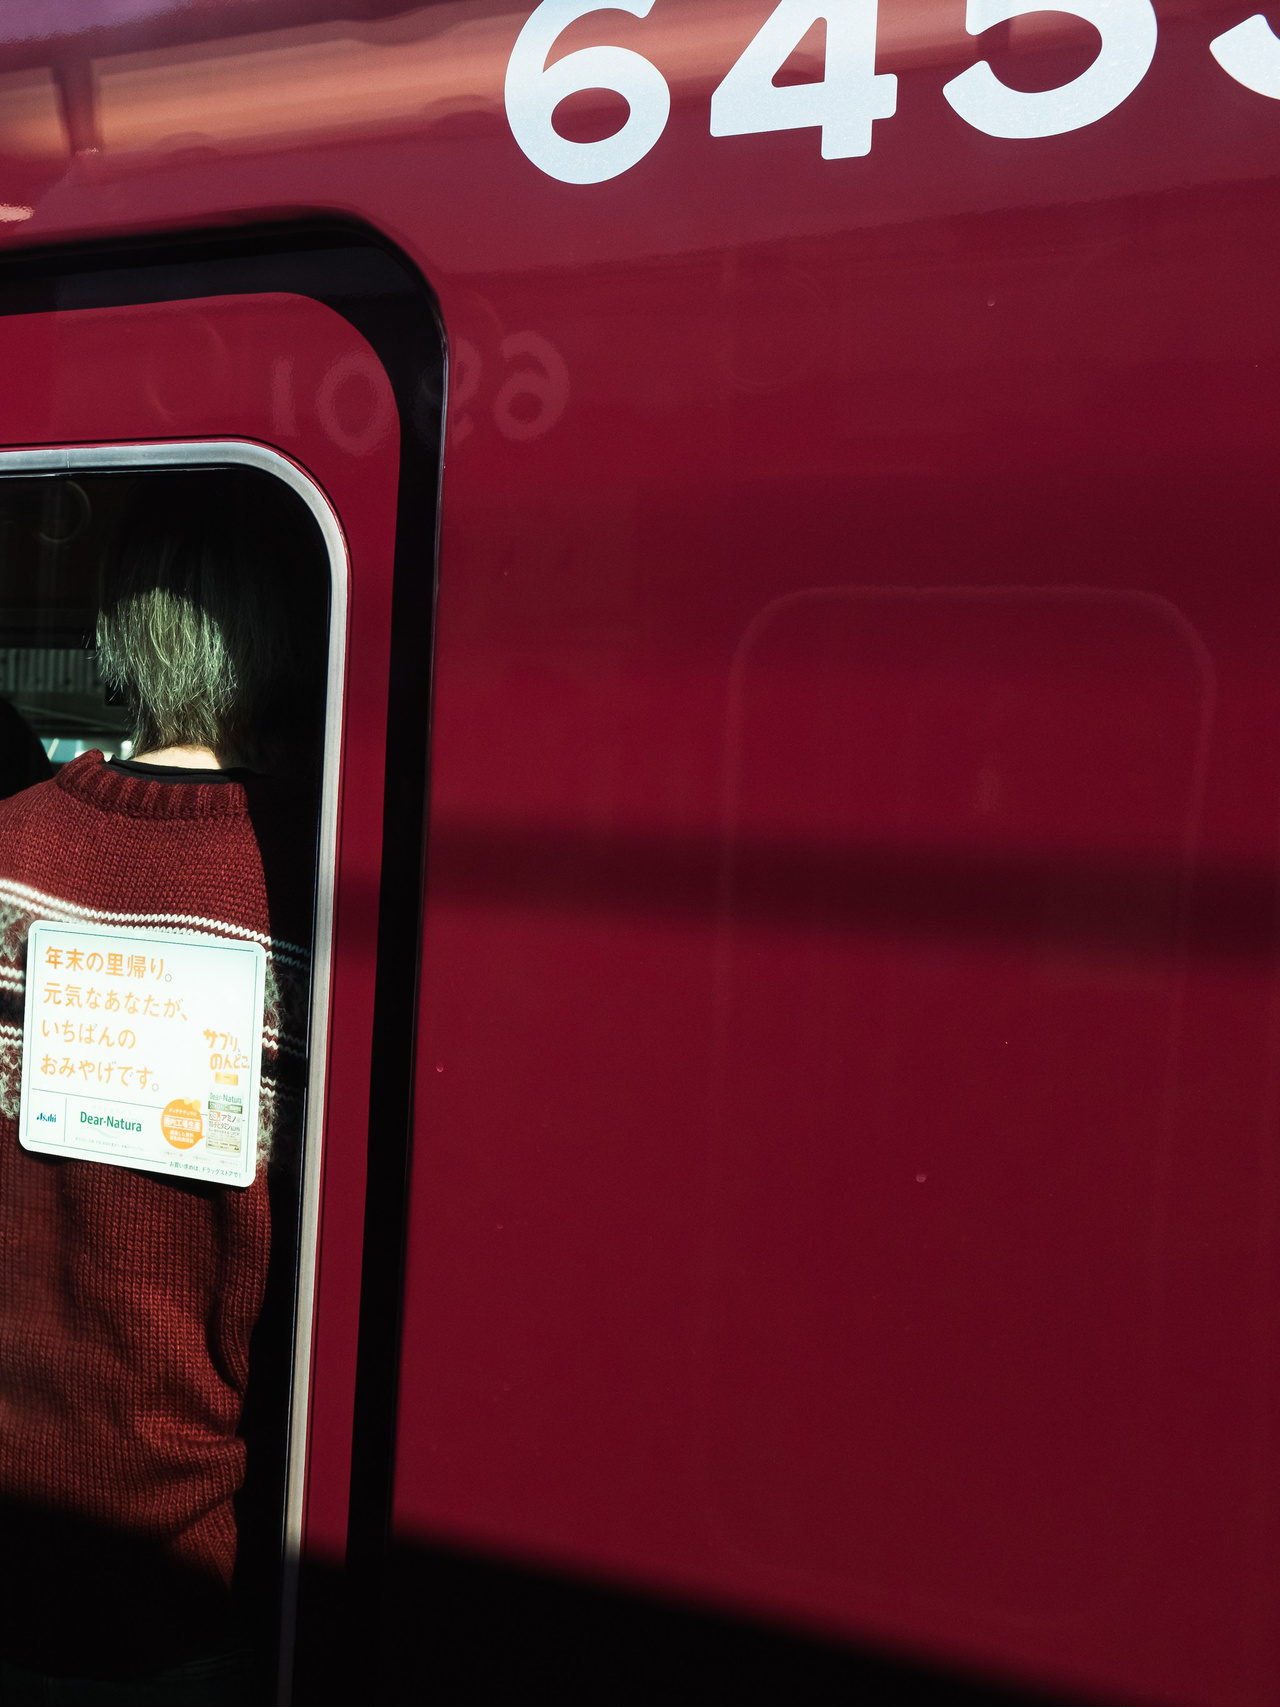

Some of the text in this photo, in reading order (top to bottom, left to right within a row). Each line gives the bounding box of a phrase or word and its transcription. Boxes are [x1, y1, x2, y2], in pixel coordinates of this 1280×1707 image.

[504, 0, 1280, 186] 645
[45, 945, 172, 983] 年末の里帰り。
[43, 981, 188, 1021] 元気なあなたが、
[41, 1018, 136, 1049] いちばんの
[40, 1053, 159, 1092] おみやげです。
[80, 1111, 142, 1132] Dear-Natura
